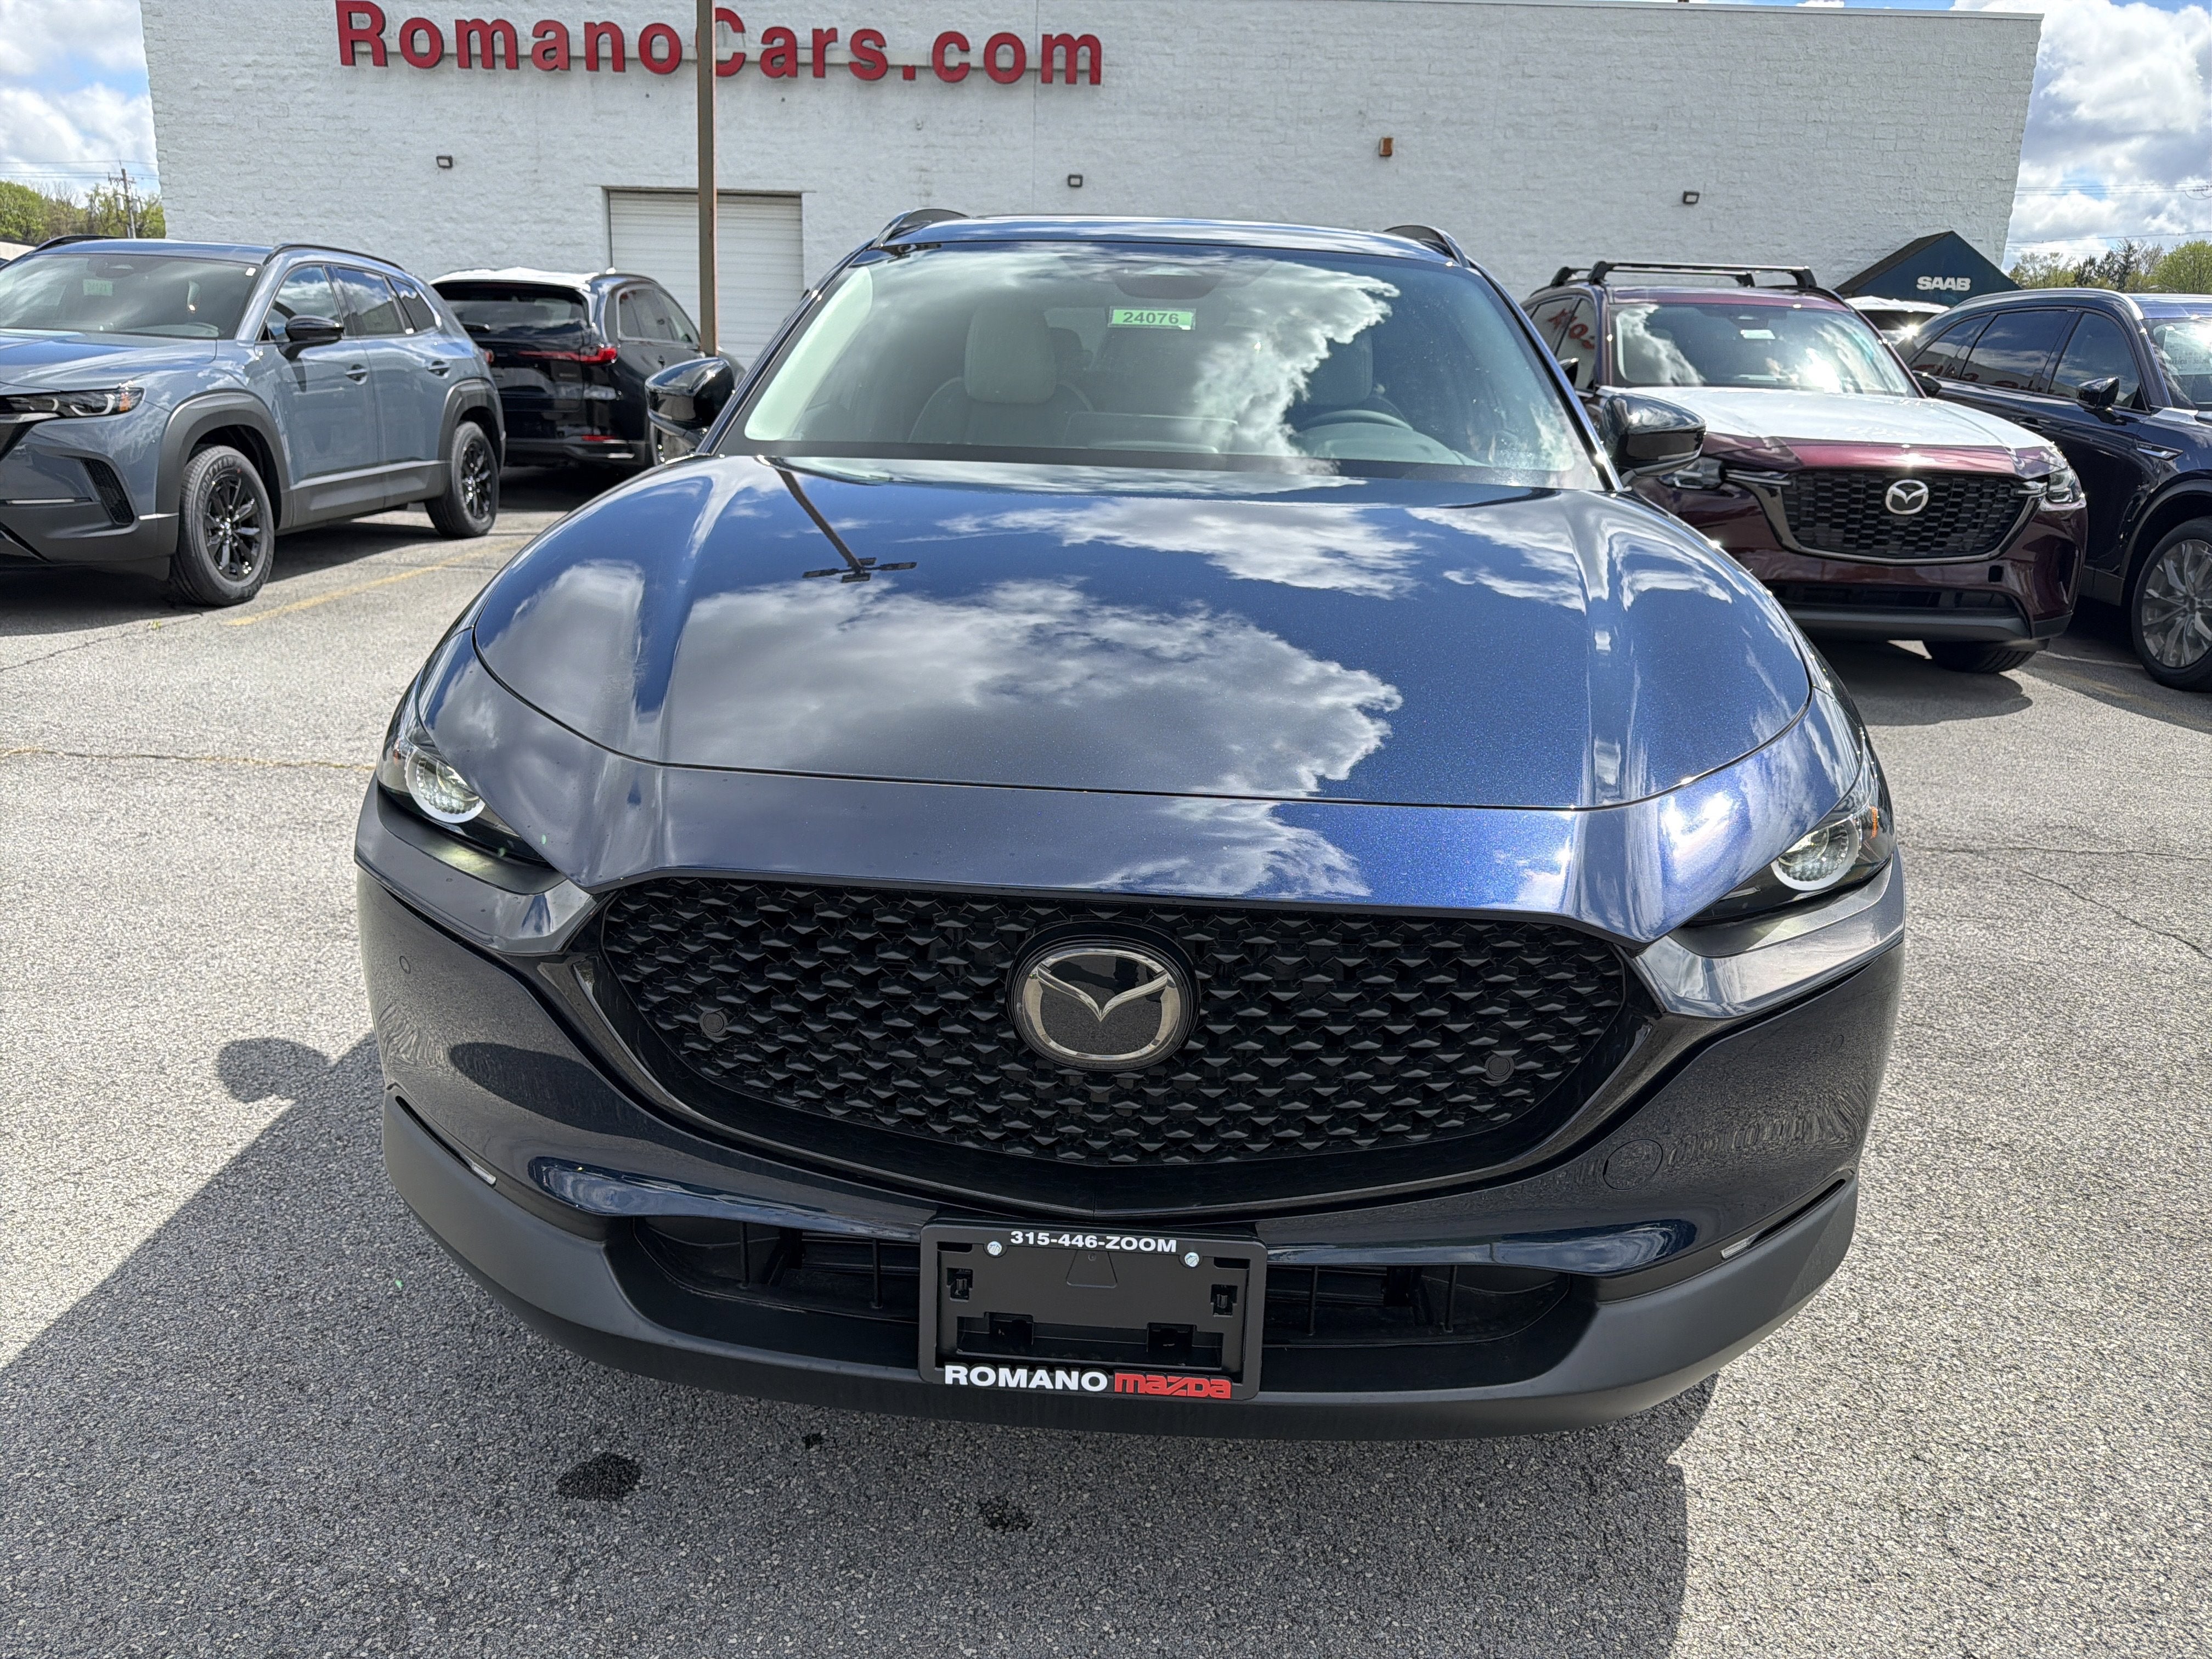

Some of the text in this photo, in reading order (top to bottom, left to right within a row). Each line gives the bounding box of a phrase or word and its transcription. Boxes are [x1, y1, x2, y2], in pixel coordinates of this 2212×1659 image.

[1916, 276, 1971, 291] SAAB
[1122, 312, 1179, 324] 24076
[1010, 1231, 1176, 1253] 315-446-ZOOM
[944, 1365, 1108, 1392] ROMANO
